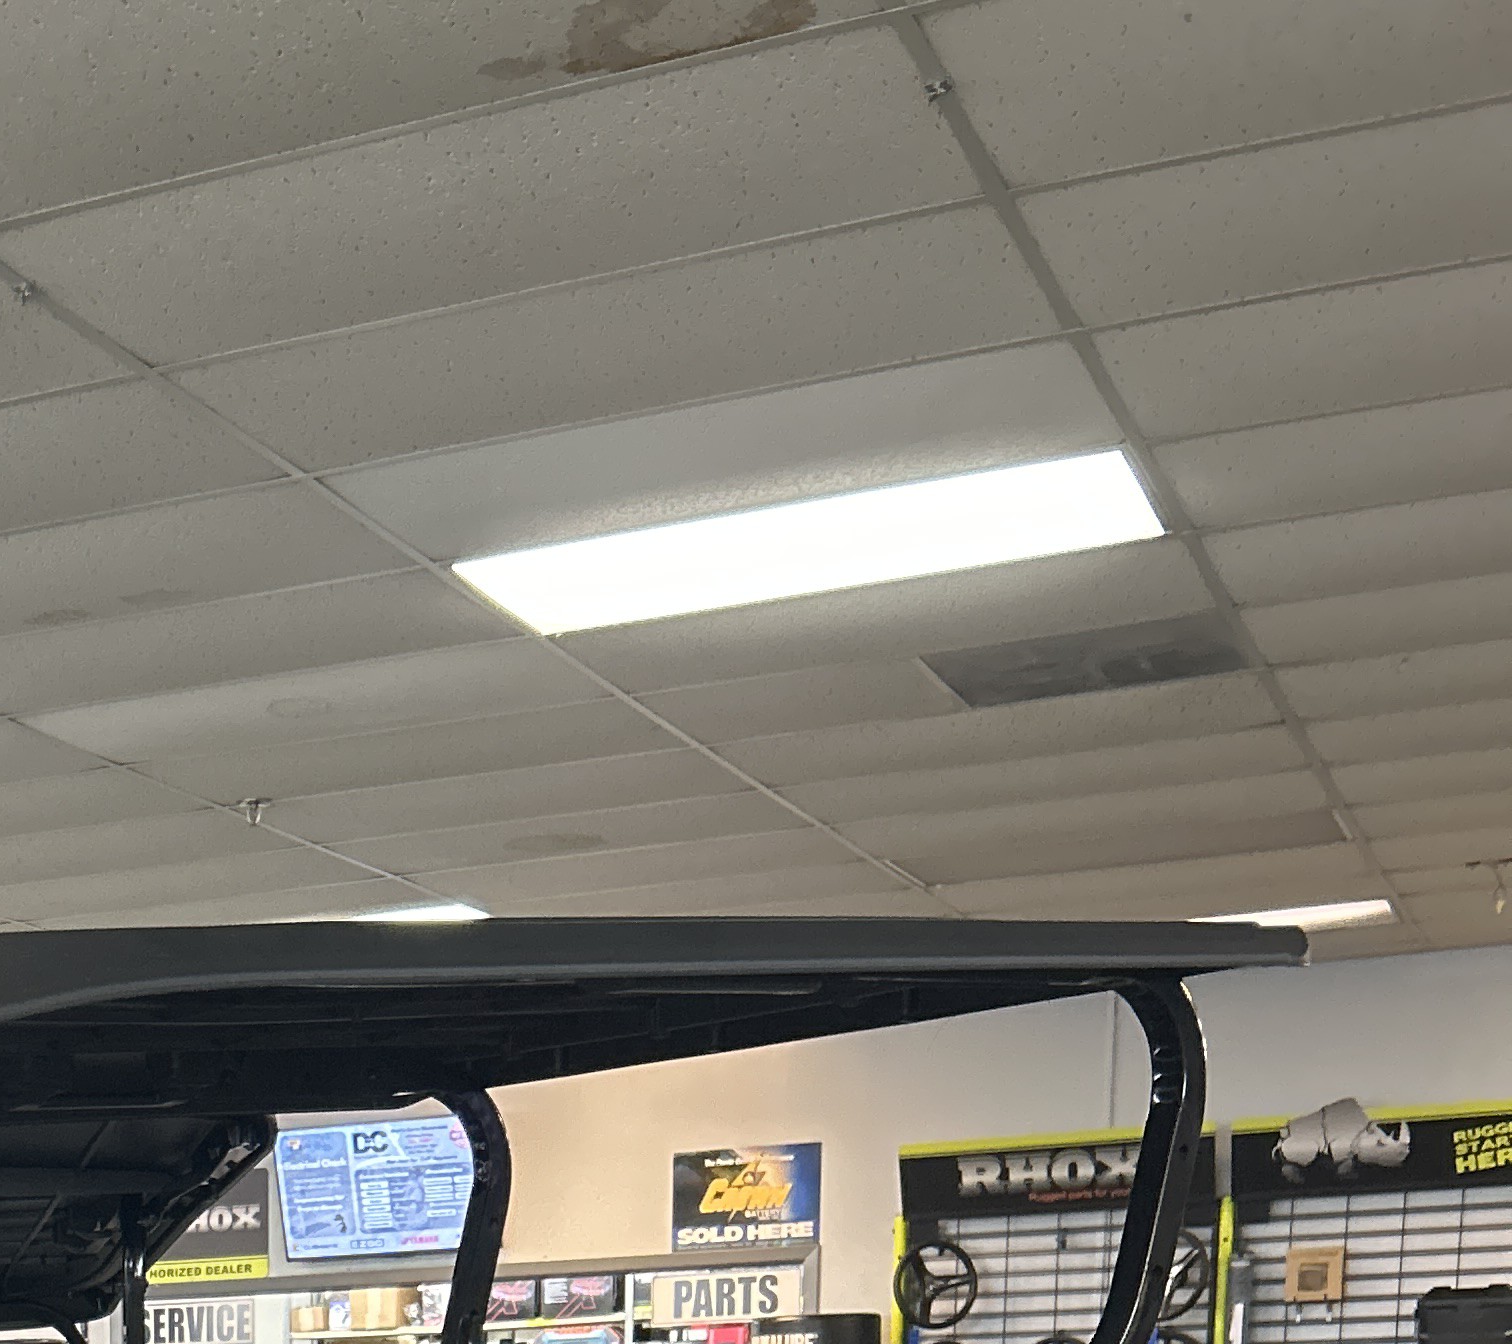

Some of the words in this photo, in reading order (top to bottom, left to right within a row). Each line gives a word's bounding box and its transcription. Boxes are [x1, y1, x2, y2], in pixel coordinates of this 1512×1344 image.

[1453, 1122, 1512, 1144] RUGG
[1455, 1135, 1512, 1156] STAR
[677, 1225, 744, 1245] SOLD
[746, 1221, 815, 1241] HERE
[149, 1266, 202, 1279] HORIZED
[205, 1264, 253, 1275] DEALER
[673, 1274, 779, 1319] PARTS
